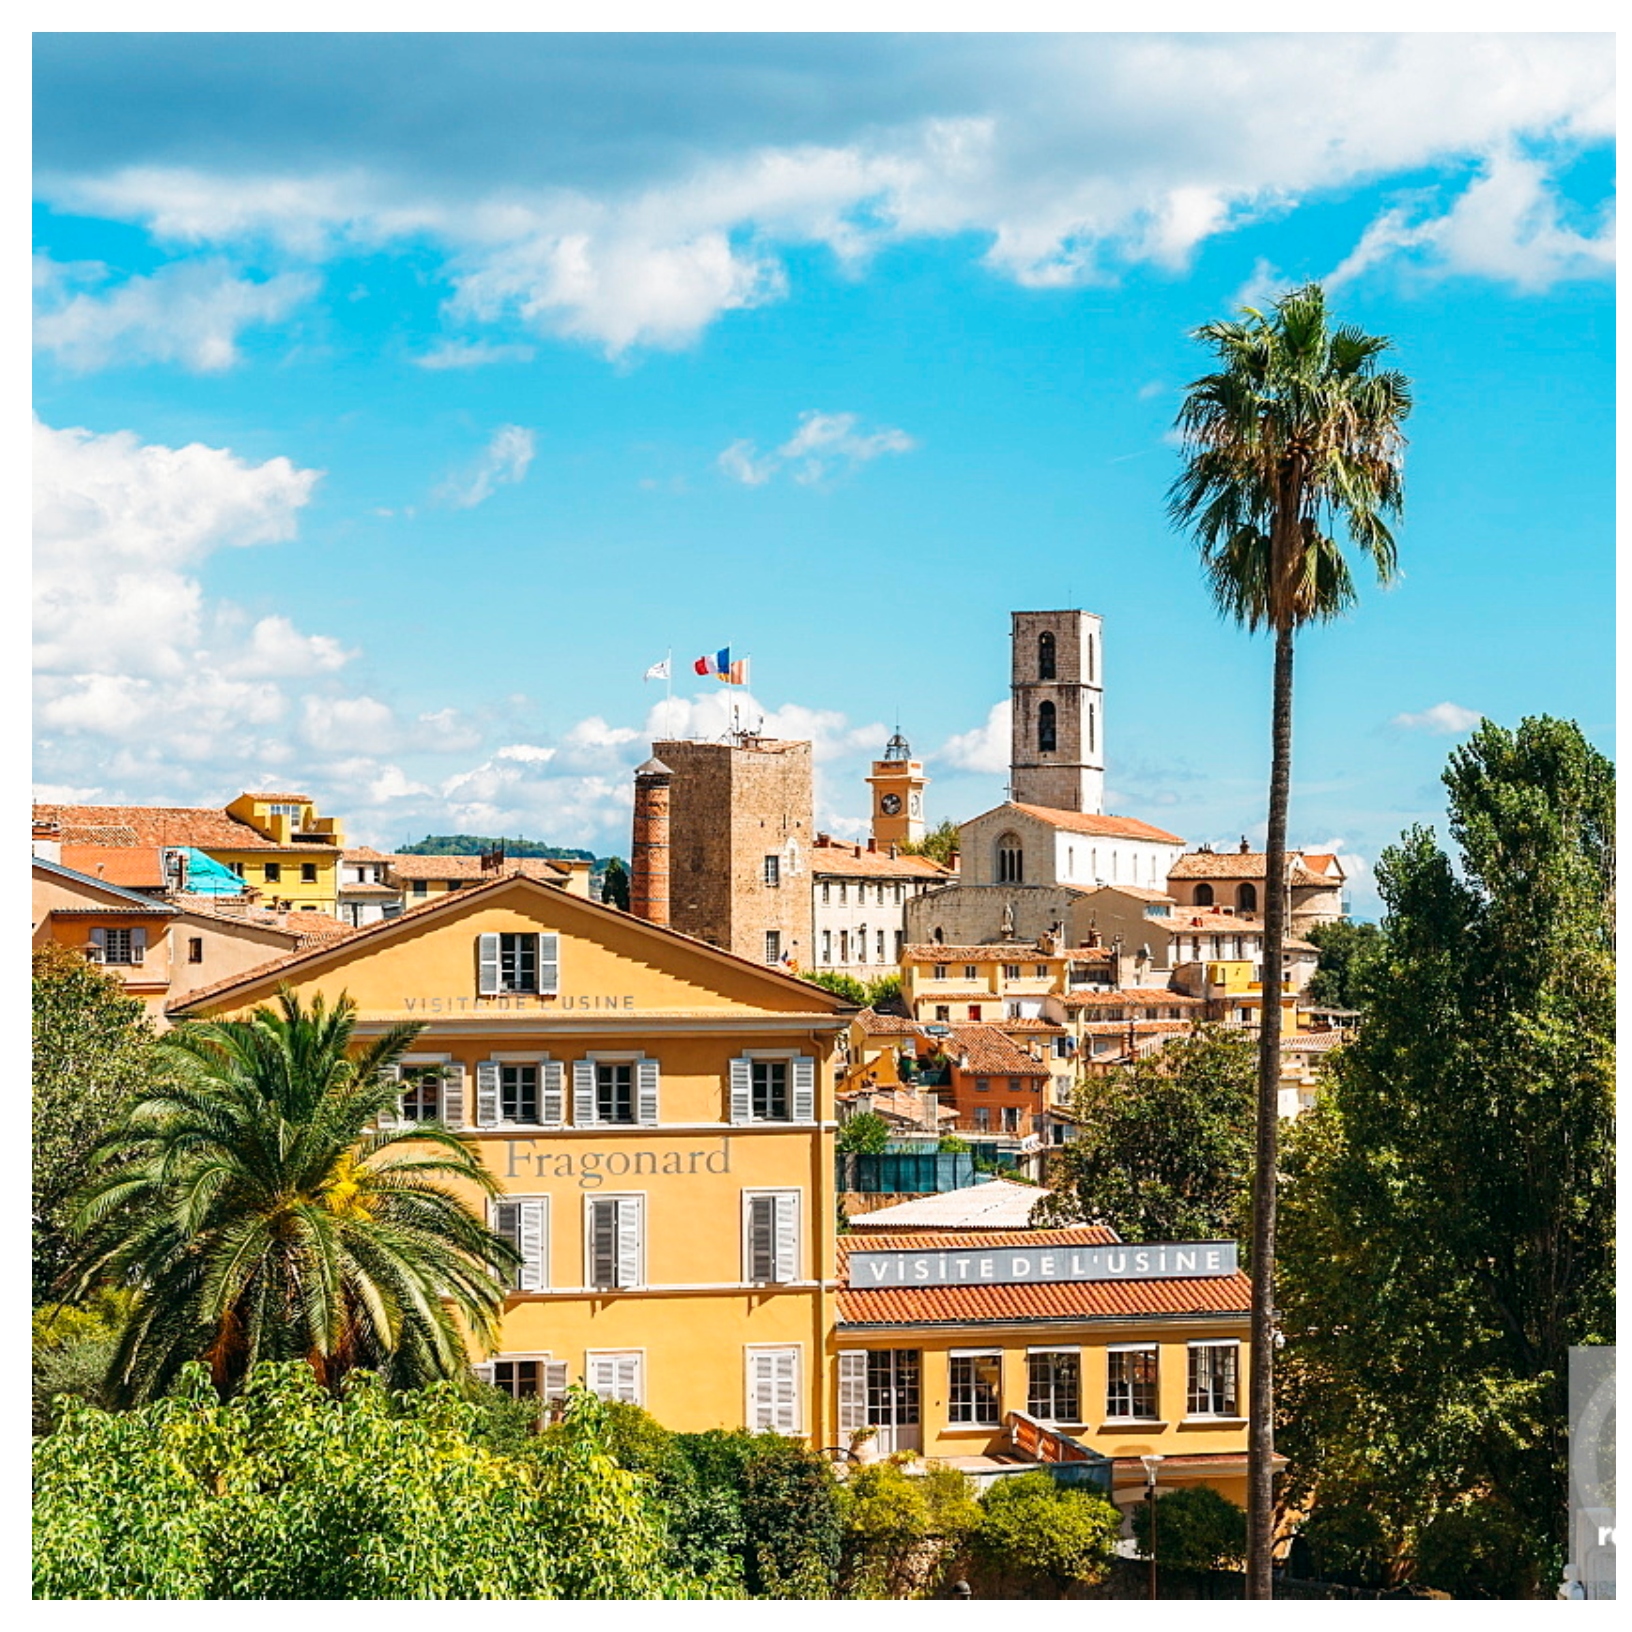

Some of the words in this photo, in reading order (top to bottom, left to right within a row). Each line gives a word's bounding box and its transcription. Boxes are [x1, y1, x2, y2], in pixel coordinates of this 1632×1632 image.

[498, 996, 526, 1011] DE
[503, 1136, 732, 1188] Fragonard
[1012, 1257, 1054, 1277] DE
